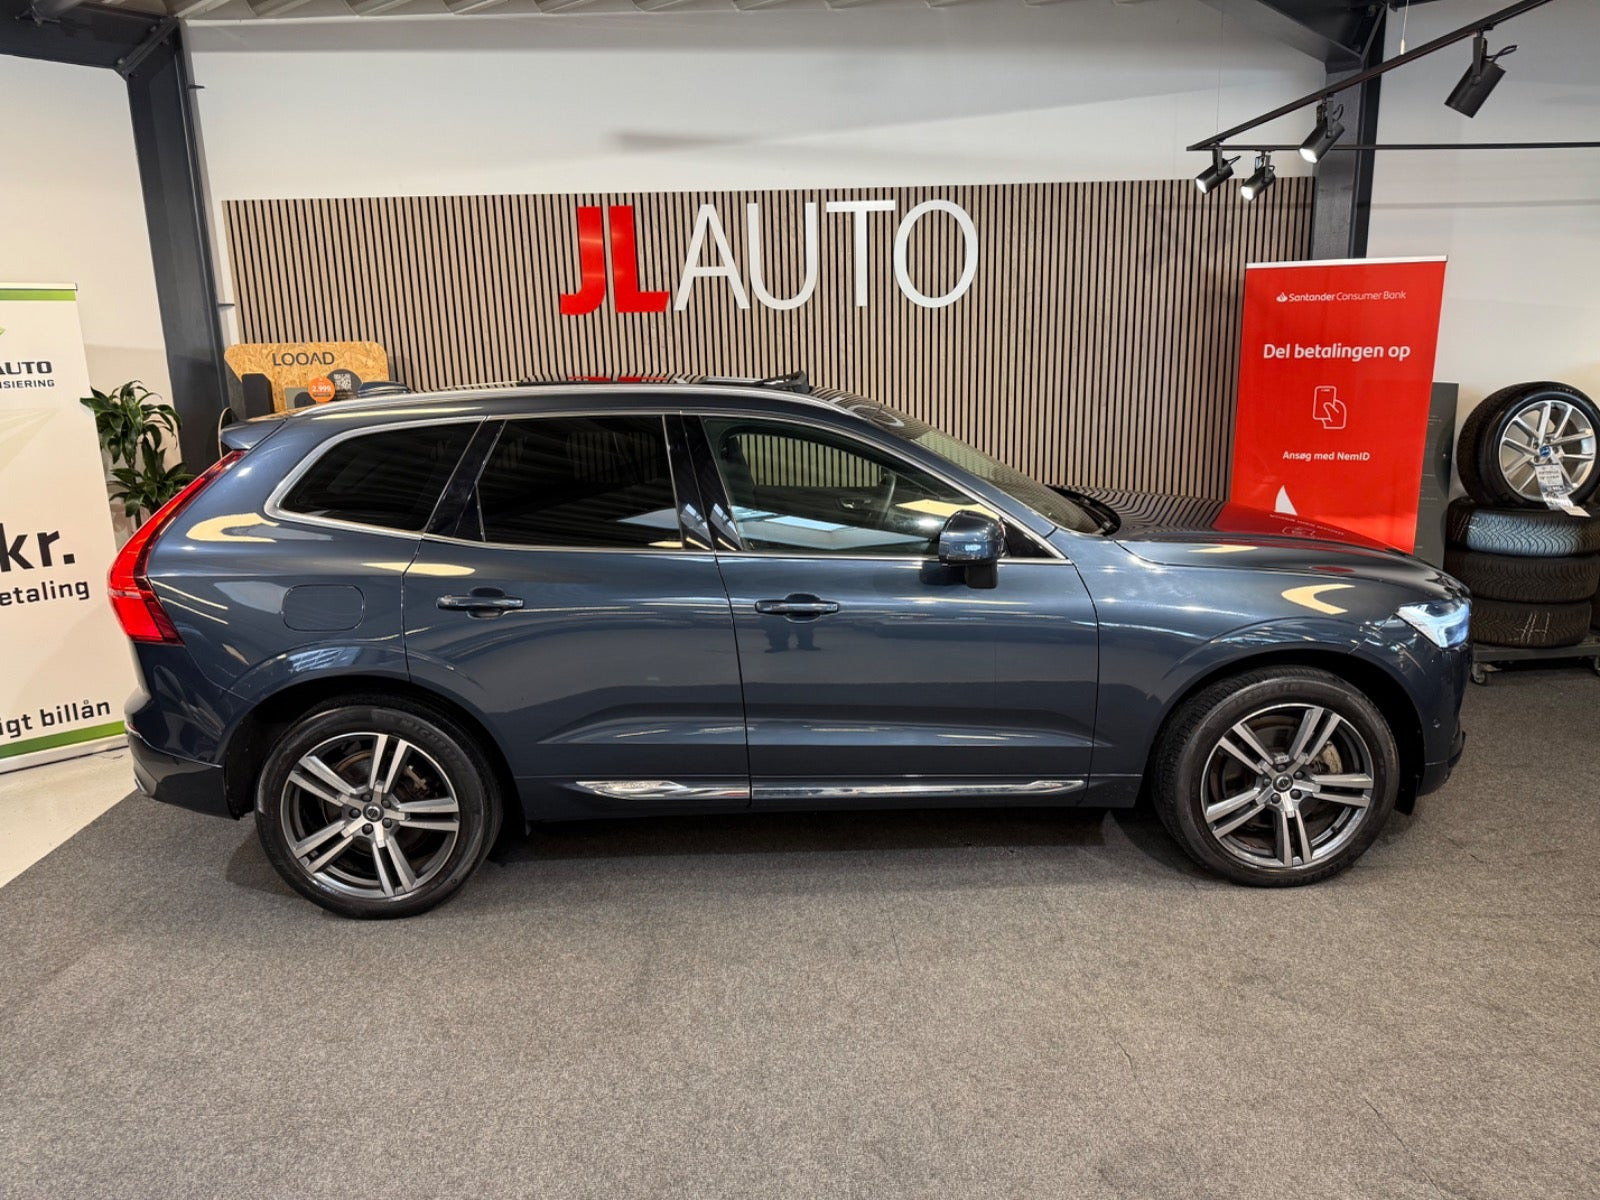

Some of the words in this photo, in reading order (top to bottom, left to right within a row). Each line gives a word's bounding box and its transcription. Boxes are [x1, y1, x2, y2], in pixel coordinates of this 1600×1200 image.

[1289, 293, 1335, 302] Santander
[1336, 292, 1381, 301] Consumer
[1383, 290, 1406, 299] Bank
[272, 352, 335, 366] LOOAD
[1263, 343, 1290, 359] Del
[1294, 343, 1384, 362] betalingen
[1388, 346, 1411, 361] op
[1283, 451, 1312, 462] Ansøg
[1314, 452, 1335, 460] med
[1337, 452, 1371, 461] NemID
[0, 523, 76, 573] kr.
[40, 699, 111, 727] billån
